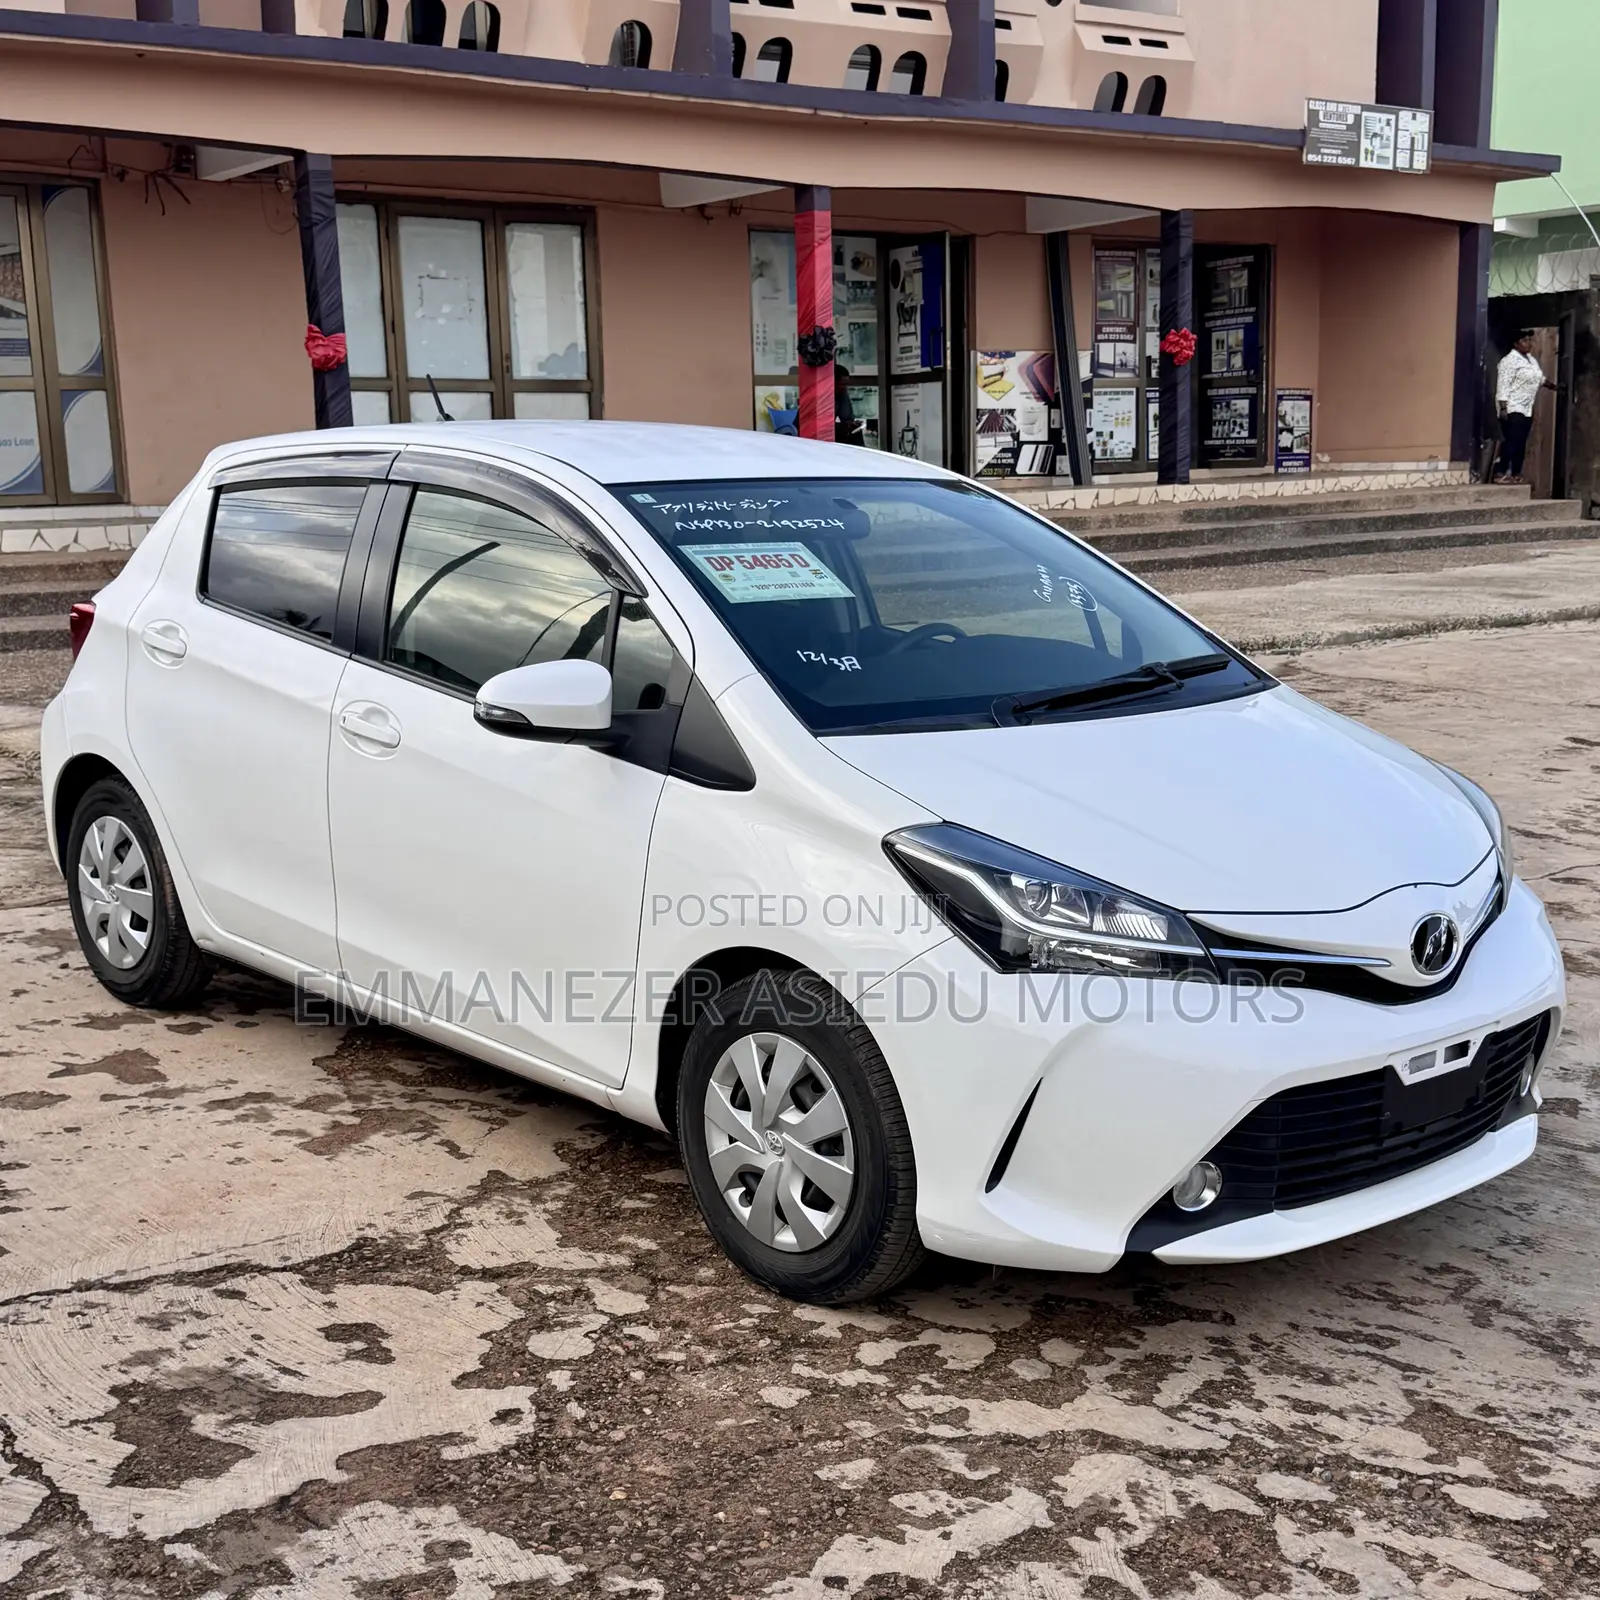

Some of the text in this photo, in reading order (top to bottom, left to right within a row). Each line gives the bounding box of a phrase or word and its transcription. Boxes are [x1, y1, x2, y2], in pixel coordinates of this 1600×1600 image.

[703, 553, 811, 572] DP 5465 D
